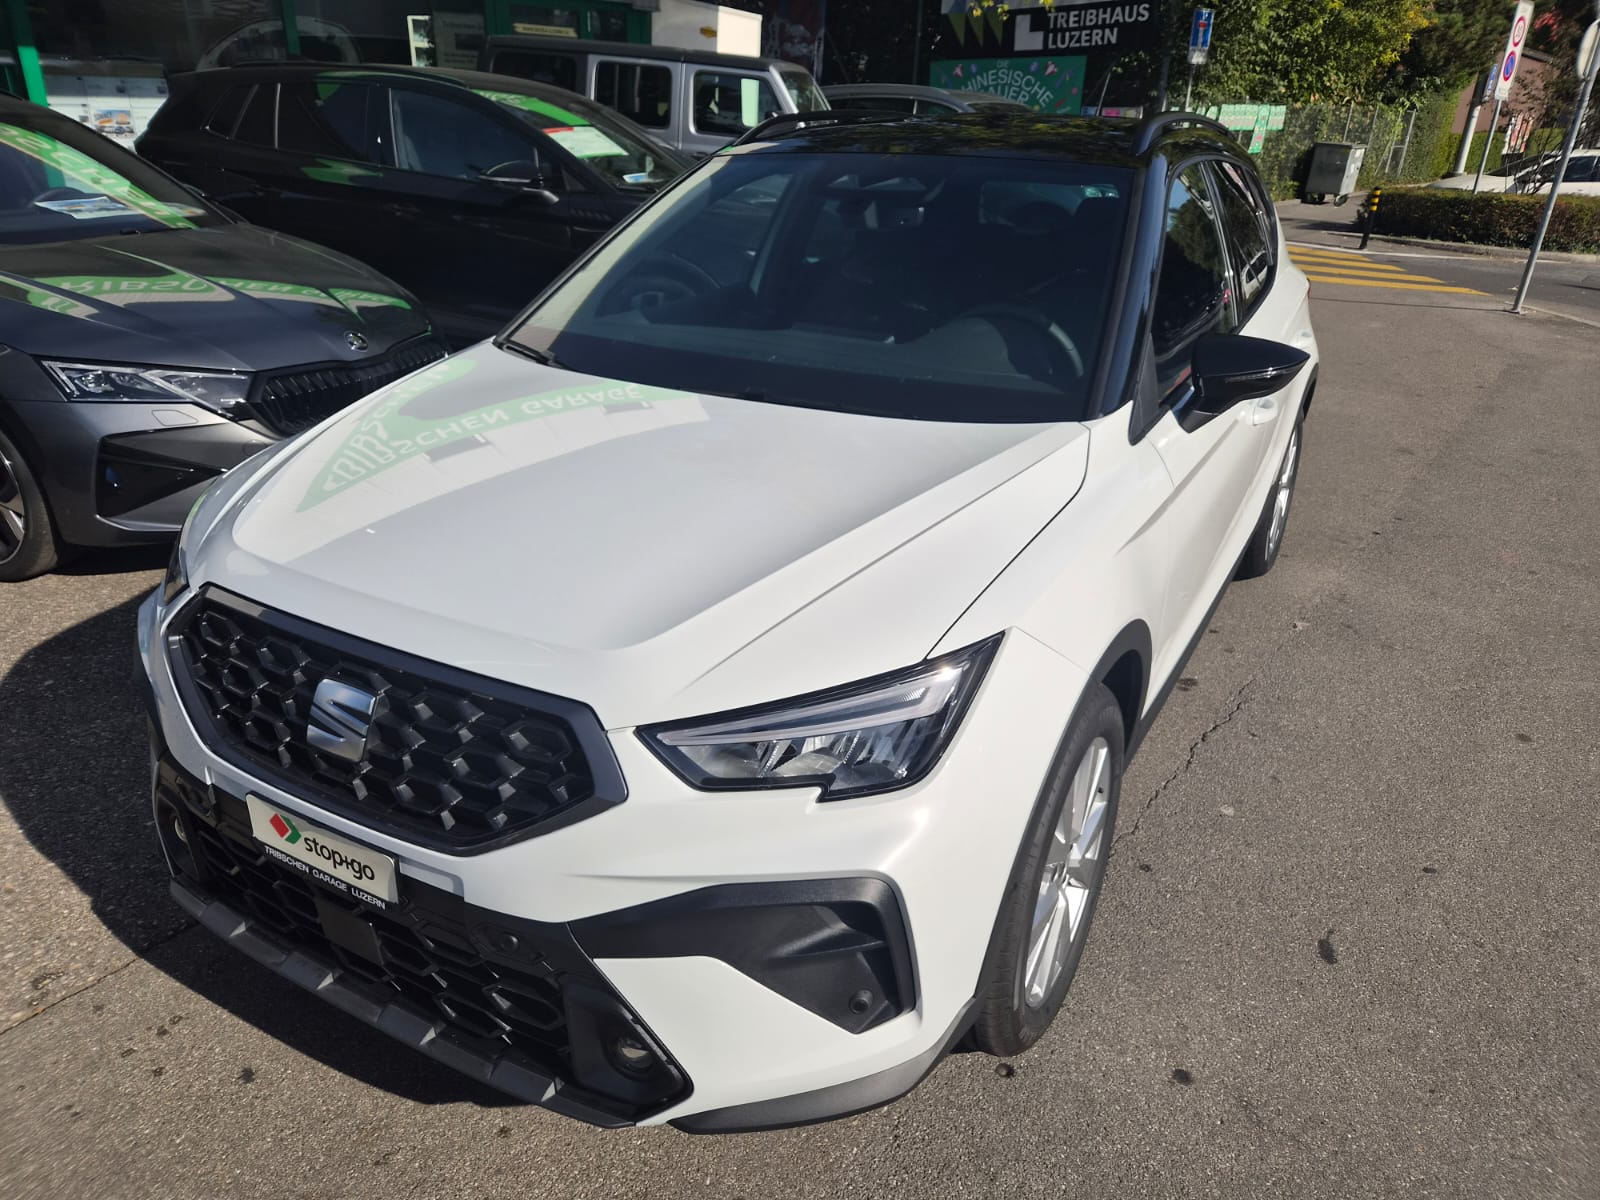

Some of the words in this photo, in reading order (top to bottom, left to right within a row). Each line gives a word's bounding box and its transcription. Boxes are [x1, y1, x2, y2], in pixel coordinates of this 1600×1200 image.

[1047, 3, 1150, 29] TREIBHAUS
[1048, 27, 1119, 49] LUZERN
[303, 836, 375, 881] stop+go
[264, 845, 310, 873] TRIBSCHEN
[312, 869, 348, 892] GARAGE
[351, 887, 386, 910] LUZERN
